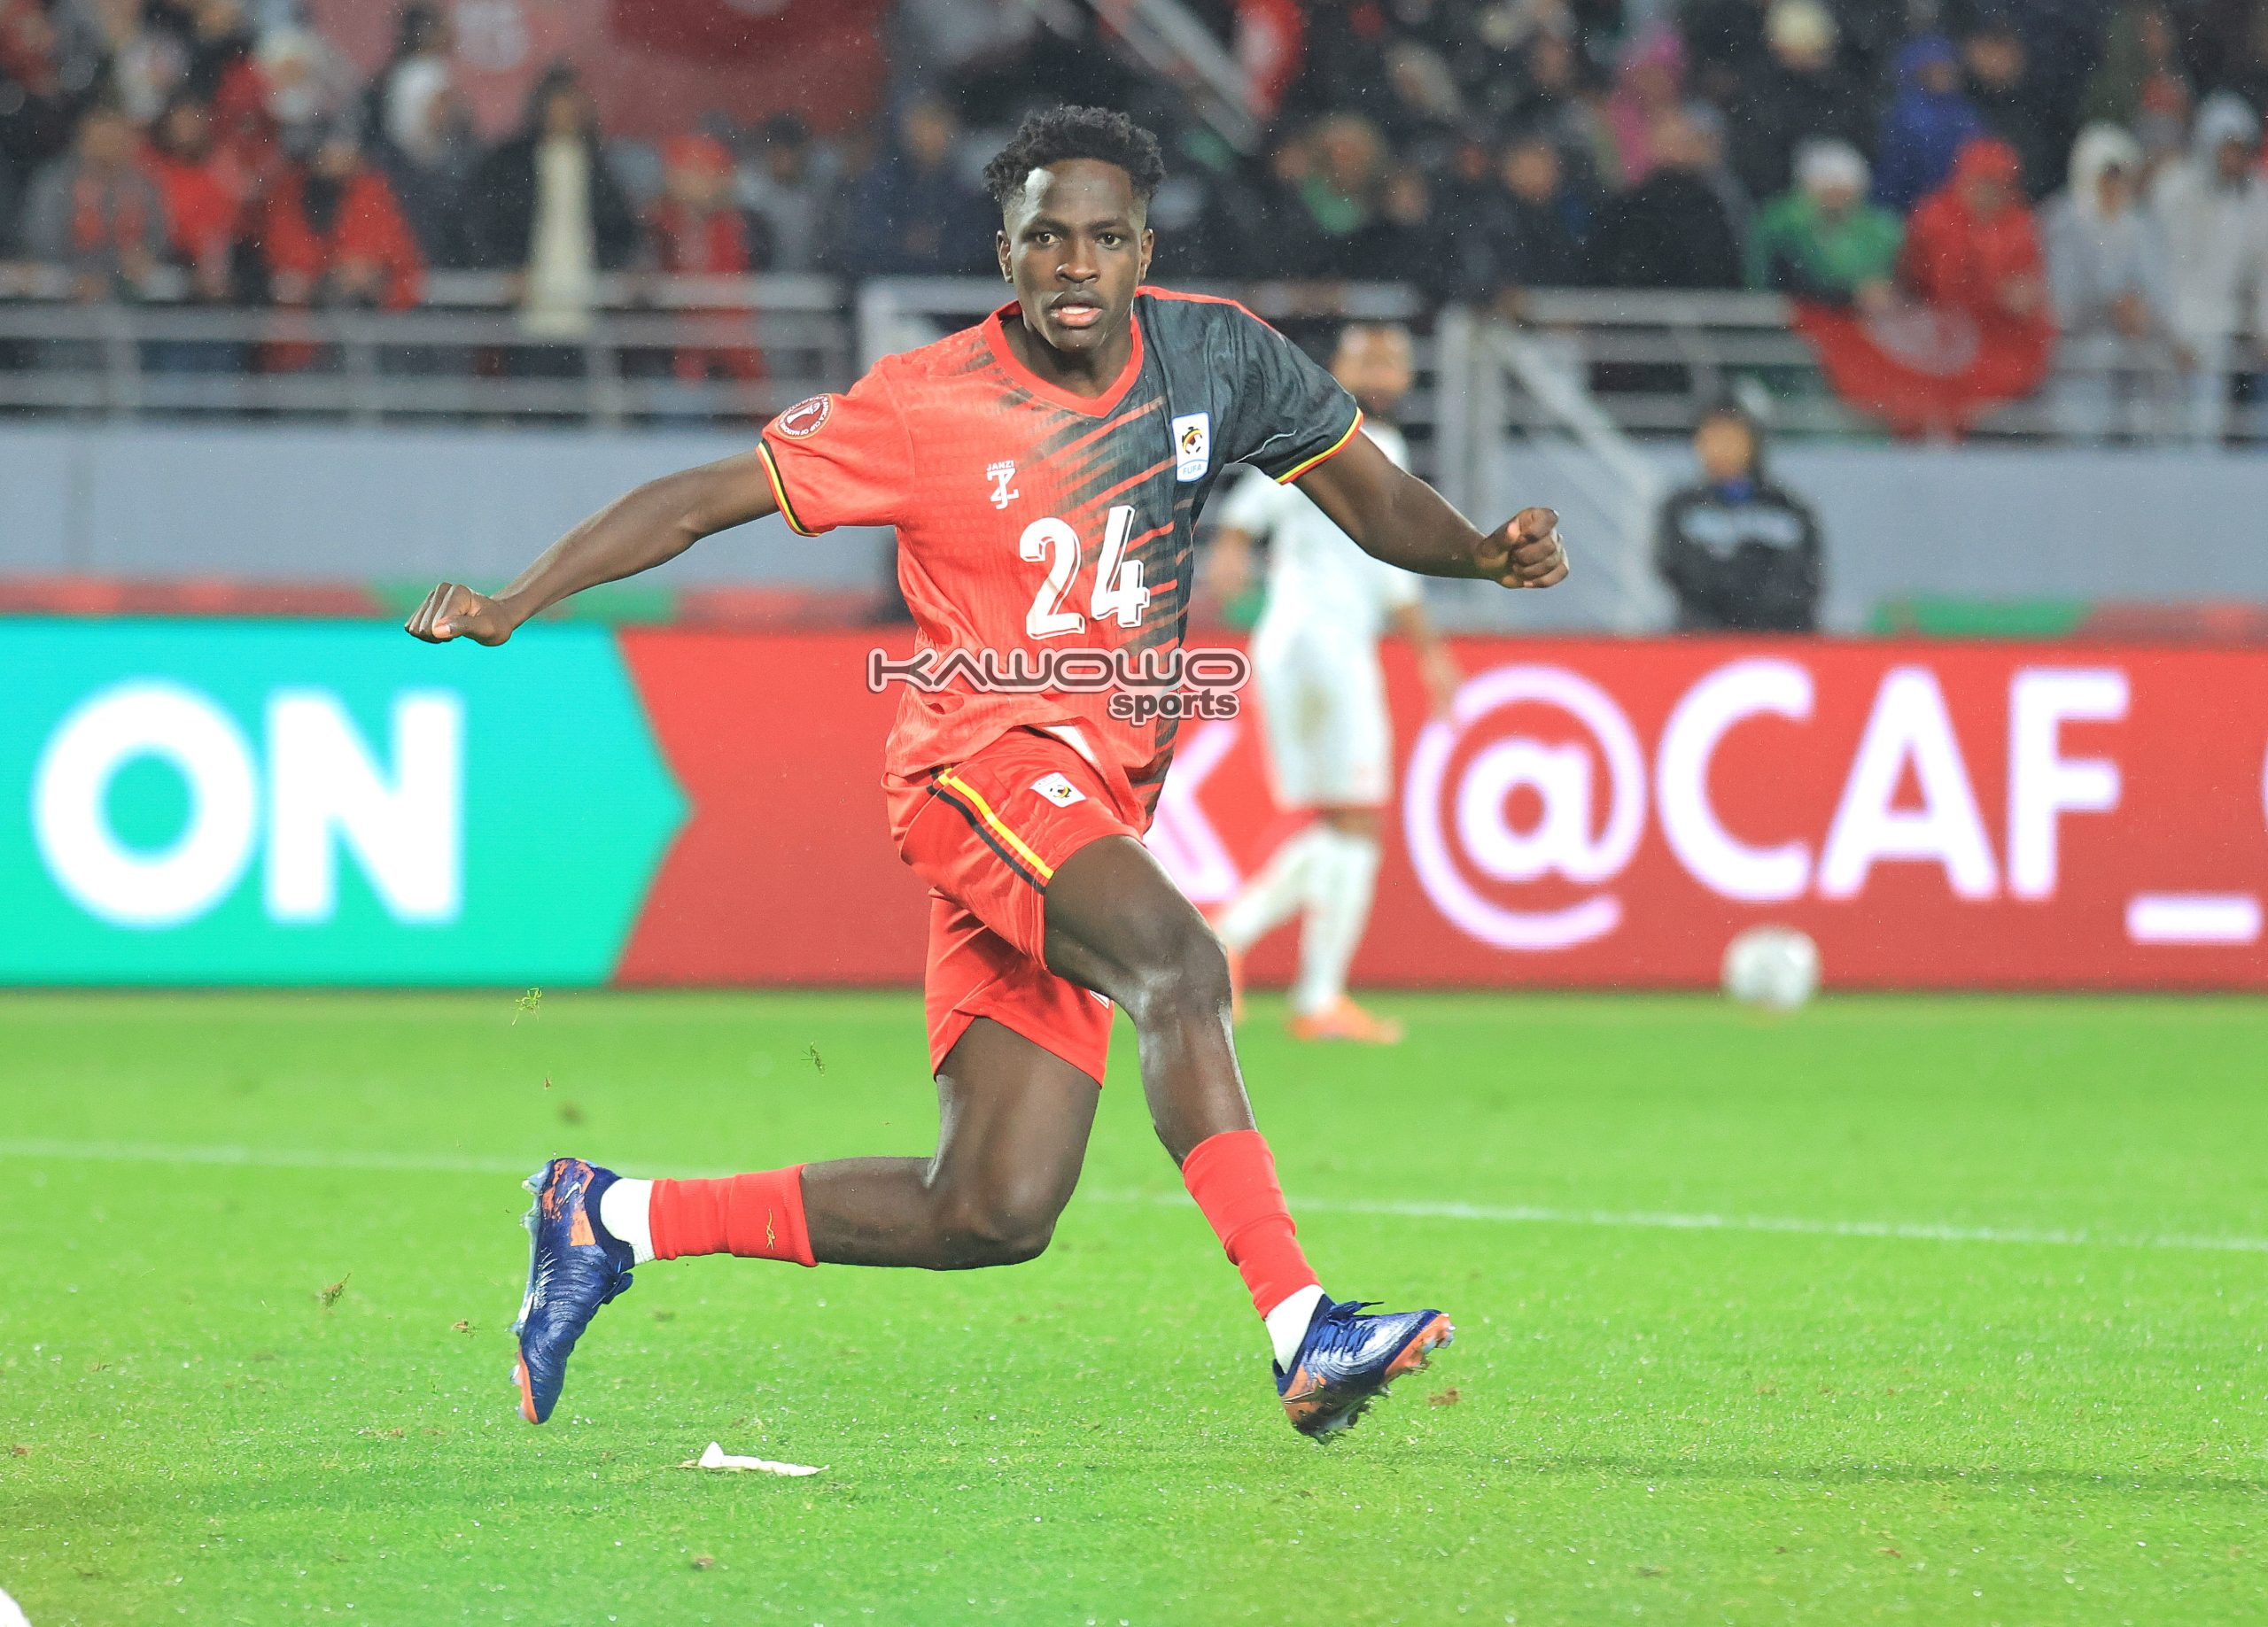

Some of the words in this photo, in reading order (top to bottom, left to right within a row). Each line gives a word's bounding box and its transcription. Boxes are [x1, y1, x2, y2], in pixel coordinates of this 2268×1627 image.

[986, 460, 1014, 471] JANZI
[1183, 463, 1202, 475] FUFA
[1020, 505, 1150, 639] 24
[32, 678, 462, 928] ON
[1404, 658, 2268, 950] @CAF_
